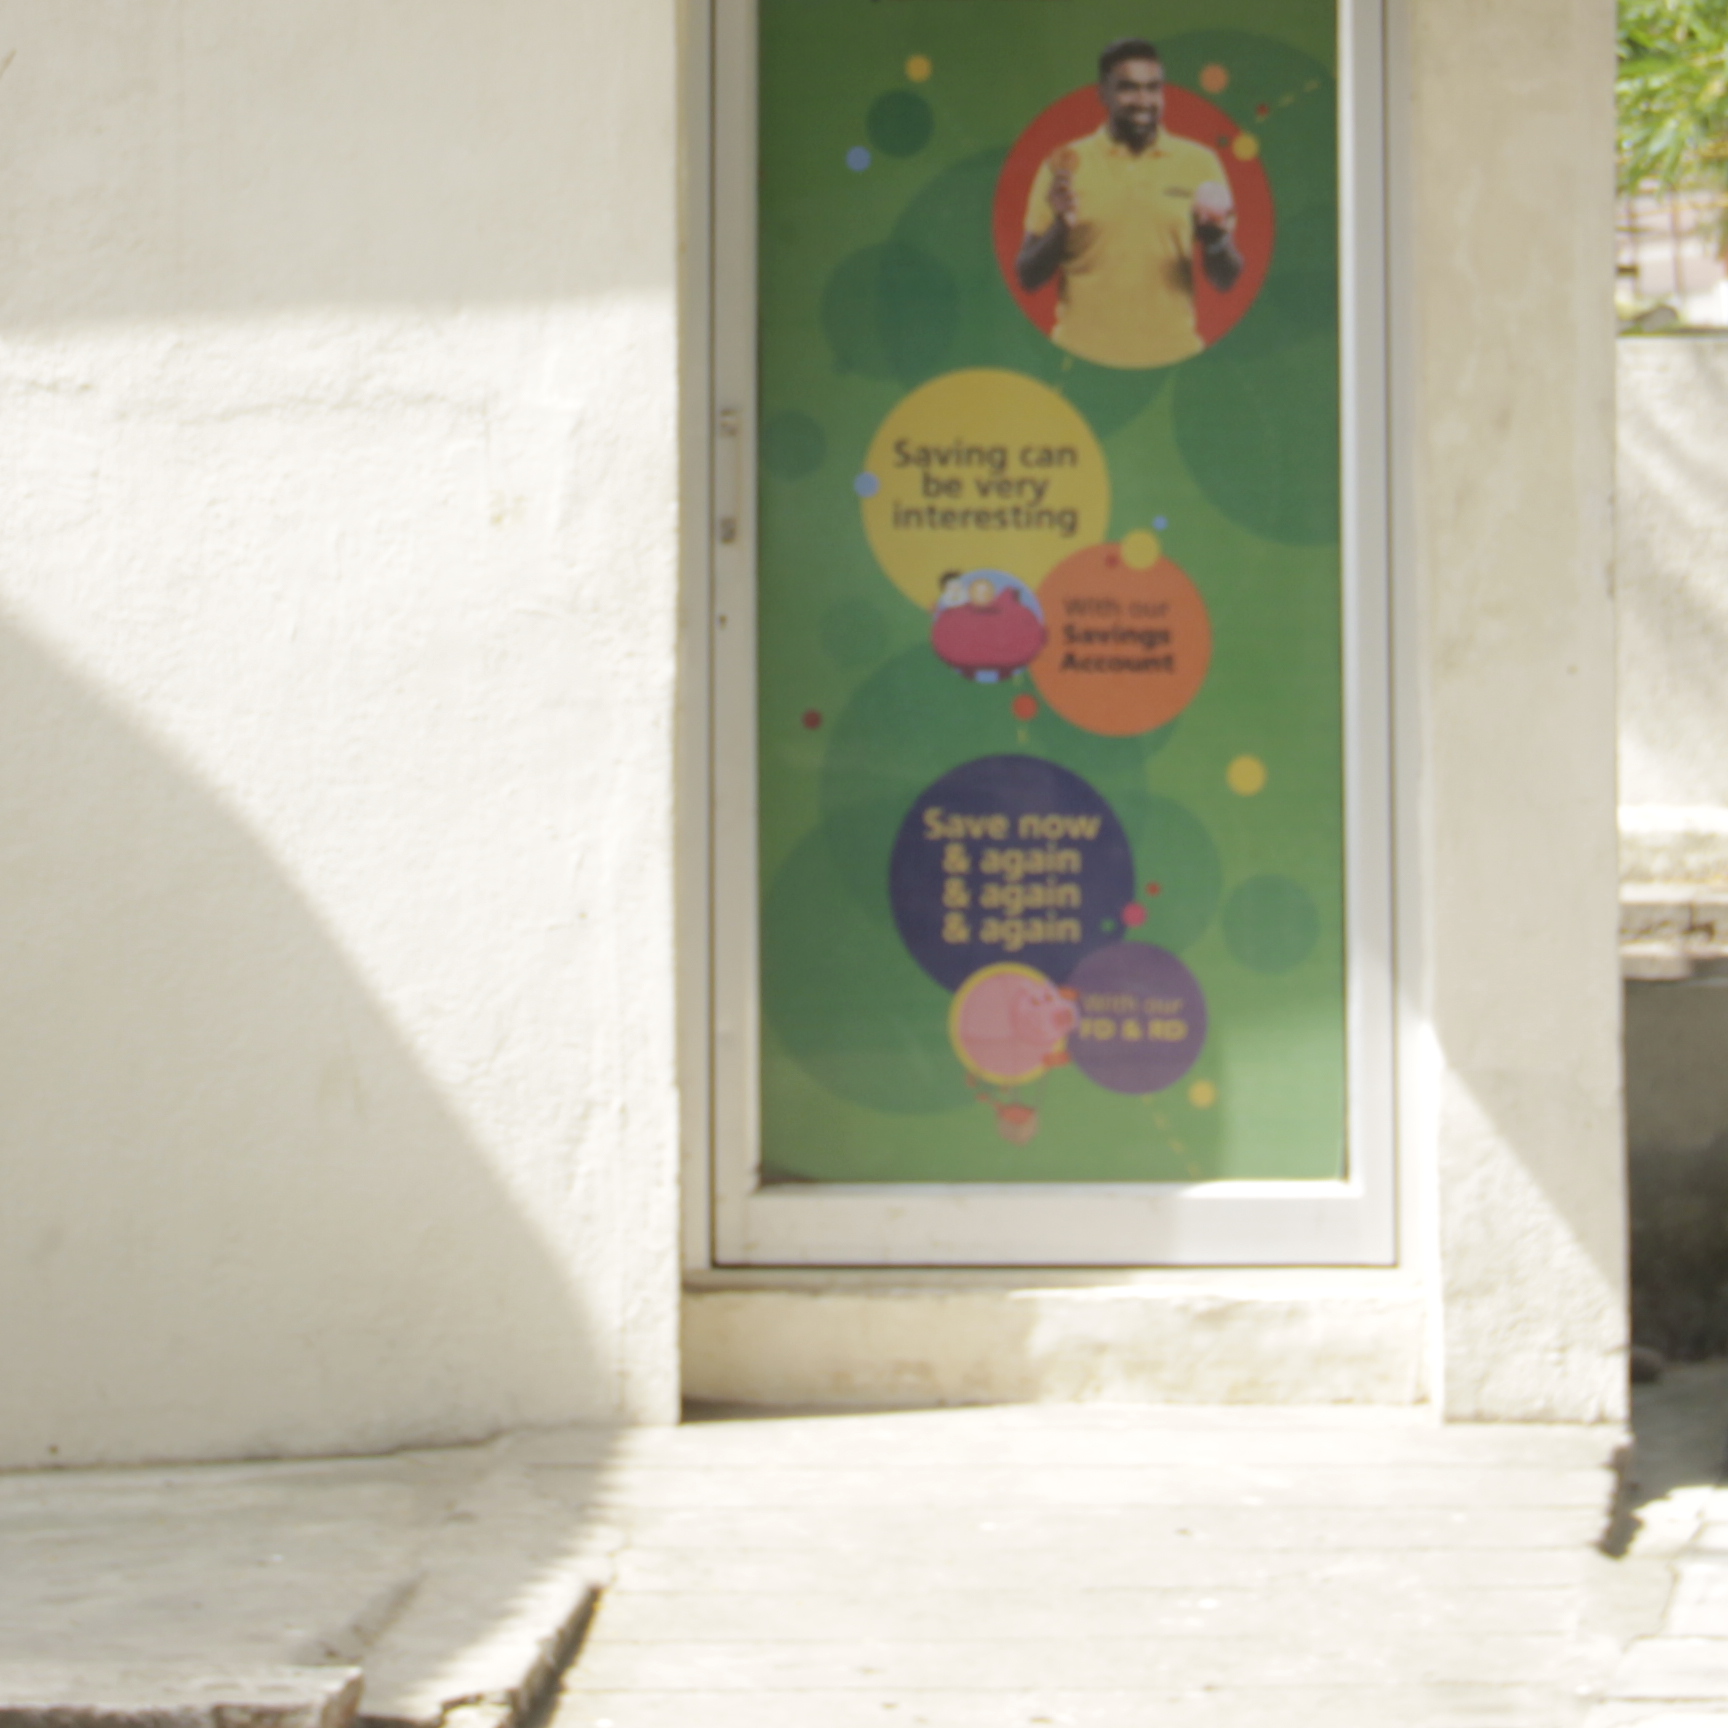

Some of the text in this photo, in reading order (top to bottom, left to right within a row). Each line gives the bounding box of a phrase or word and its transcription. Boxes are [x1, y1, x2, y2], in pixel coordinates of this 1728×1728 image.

[893, 438, 1078, 473] Saving can
[922, 470, 1050, 504] be very
[892, 501, 1079, 536] interesting
[1062, 596, 1120, 617] With
[1062, 623, 1171, 650] Savings
[1060, 652, 1176, 674] Account
[923, 807, 1102, 842] Save now
[942, 843, 1082, 884] & again
[942, 876, 1082, 917] & again
[942, 910, 1082, 952] & again
[1121, 1018, 1144, 1042] &
